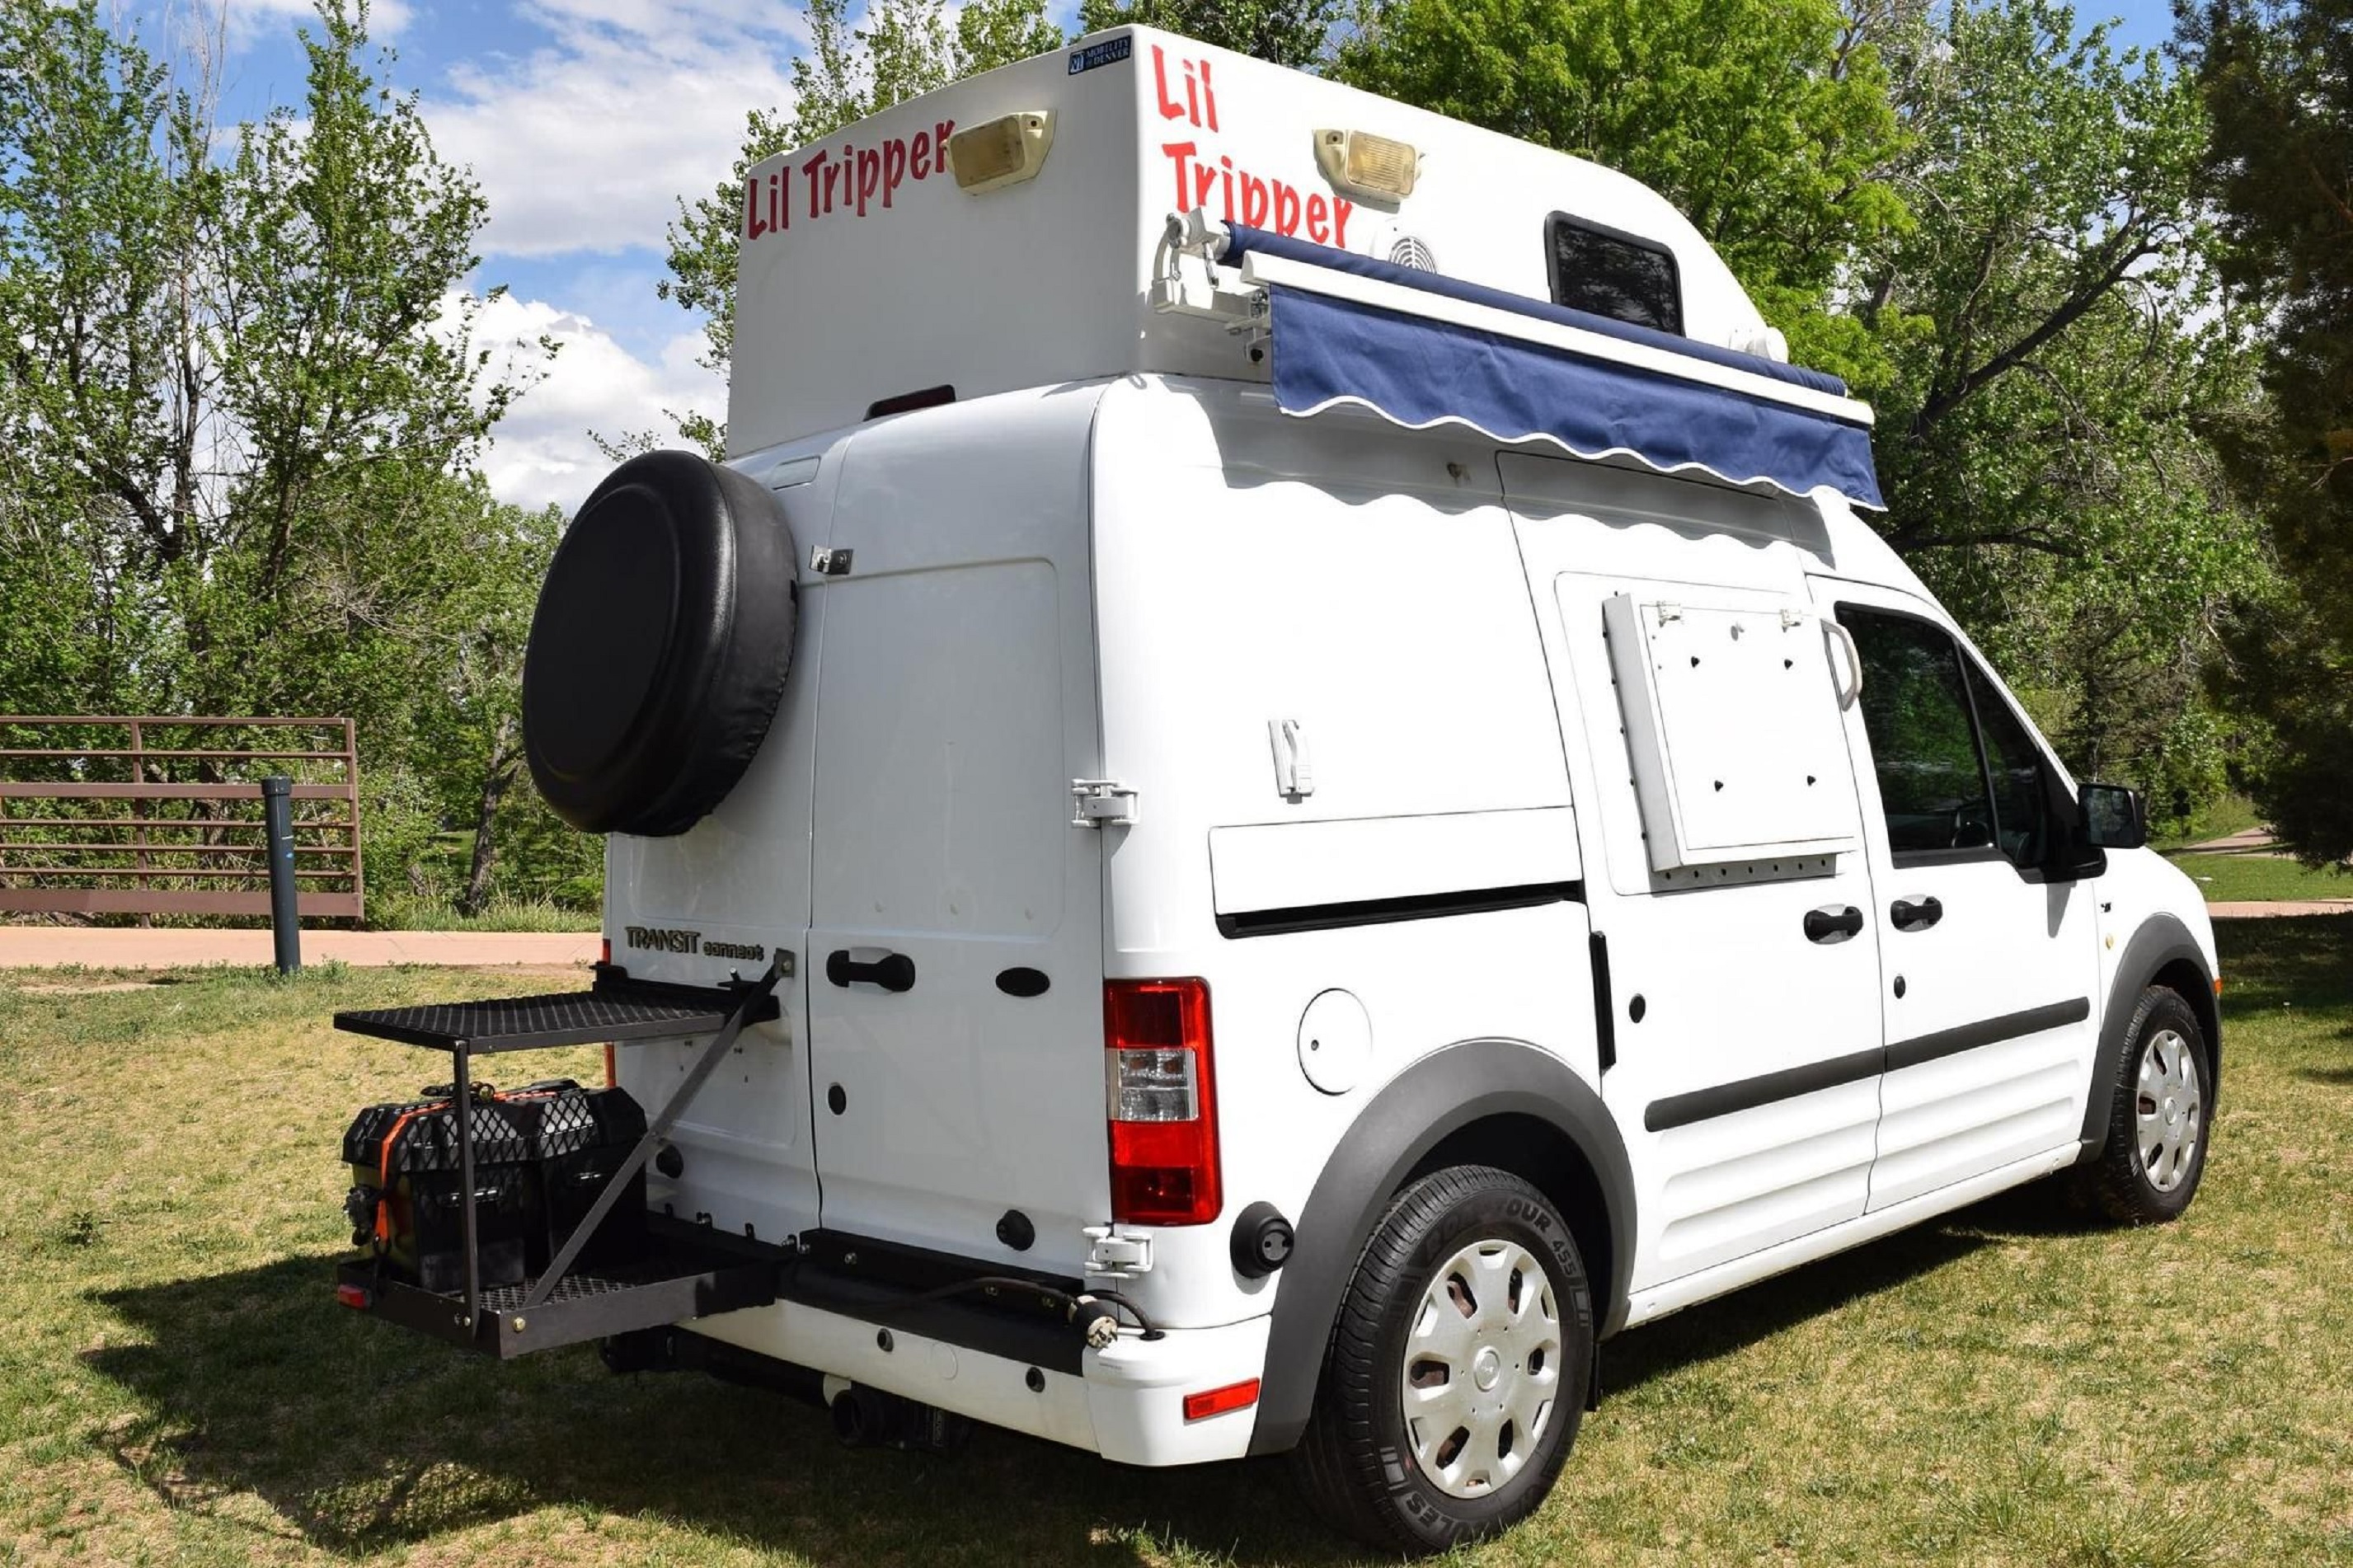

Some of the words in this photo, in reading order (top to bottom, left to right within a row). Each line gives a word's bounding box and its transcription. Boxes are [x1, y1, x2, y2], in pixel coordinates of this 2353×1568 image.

[1151, 44, 1219, 134] Lil
[748, 166, 790, 241] Lil
[801, 120, 956, 219] Tripper
[1161, 141, 1353, 249] Tripper
[624, 925, 701, 954] TRANSIT
[702, 941, 765, 962] connect
